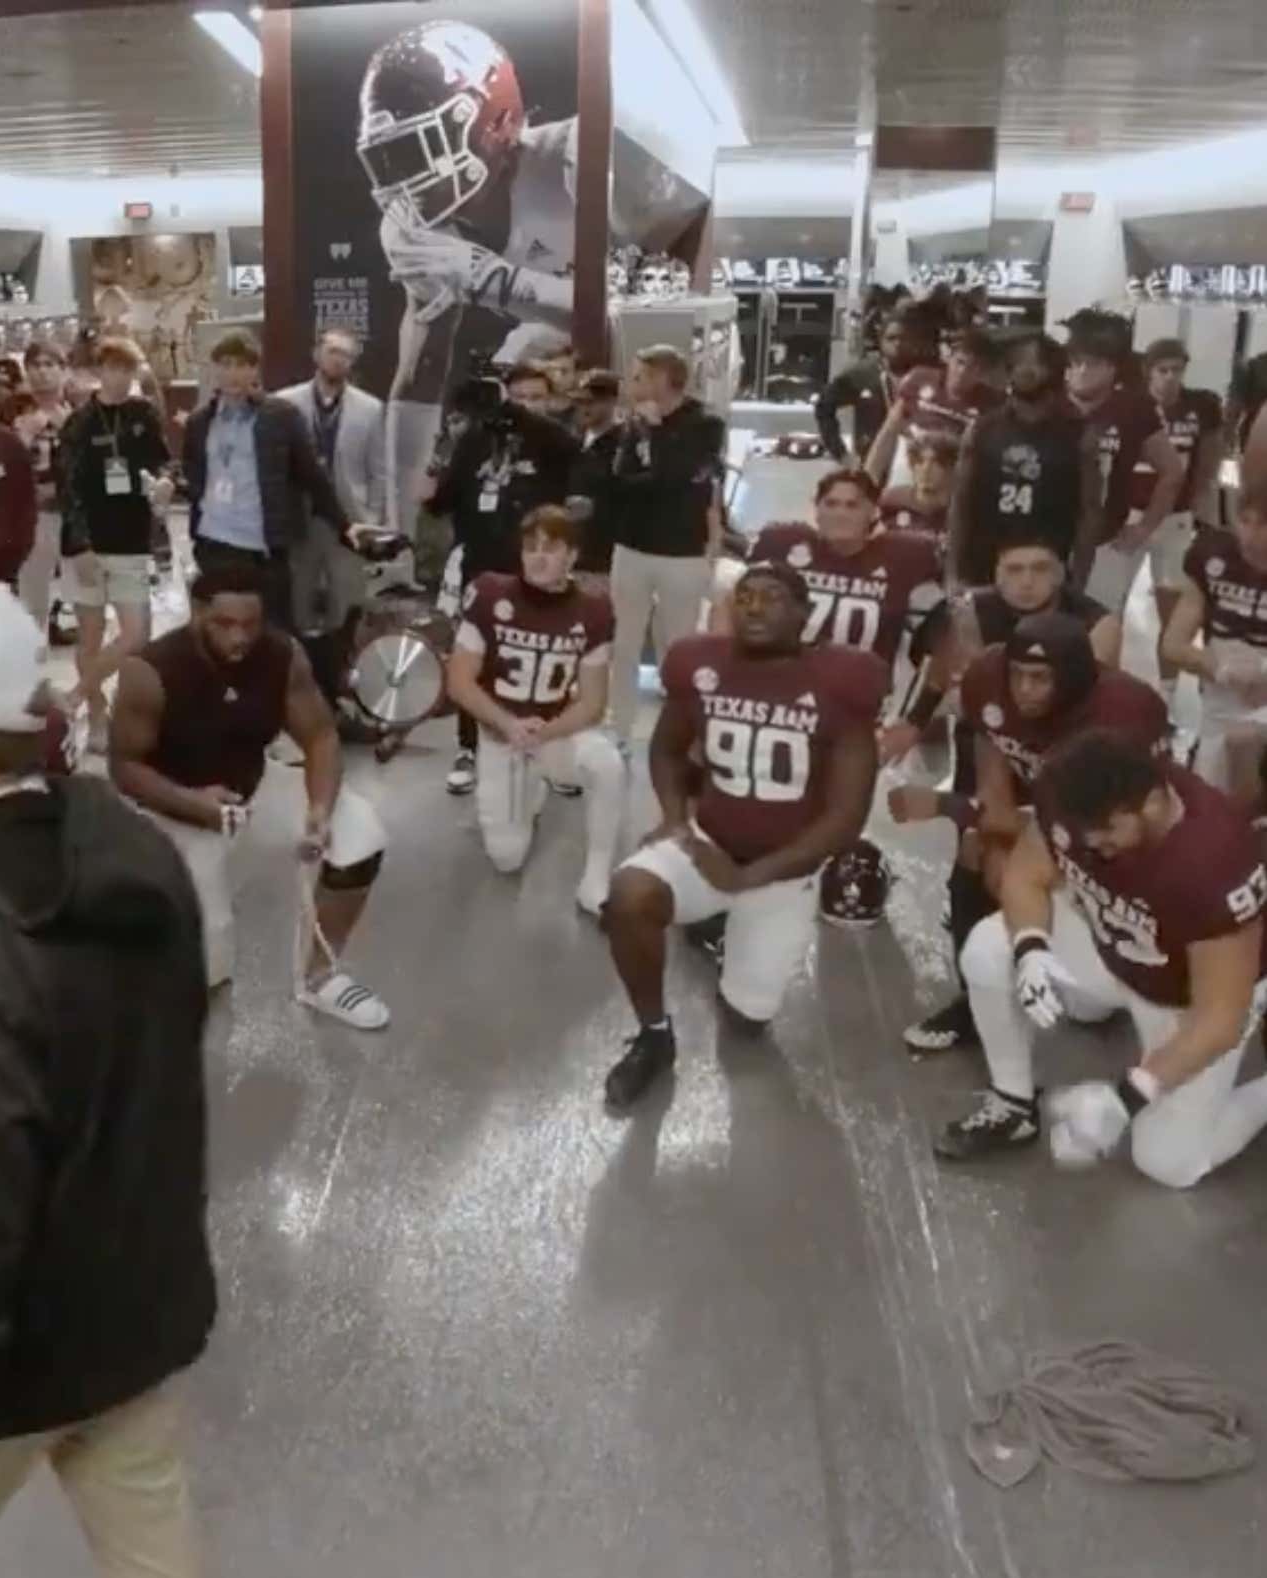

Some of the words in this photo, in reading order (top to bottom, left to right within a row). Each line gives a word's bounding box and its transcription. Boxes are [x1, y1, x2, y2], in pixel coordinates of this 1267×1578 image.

[314, 298, 369, 317] TEXAS
[998, 483, 1033, 514] 24
[796, 569, 849, 594] TEXAS
[494, 624, 550, 651] TEXAS
[799, 591, 880, 654] 70
[494, 643, 580, 703] 30
[700, 693, 770, 724] TEXAS
[769, 703, 819, 735] A&M
[705, 717, 810, 802] 90
